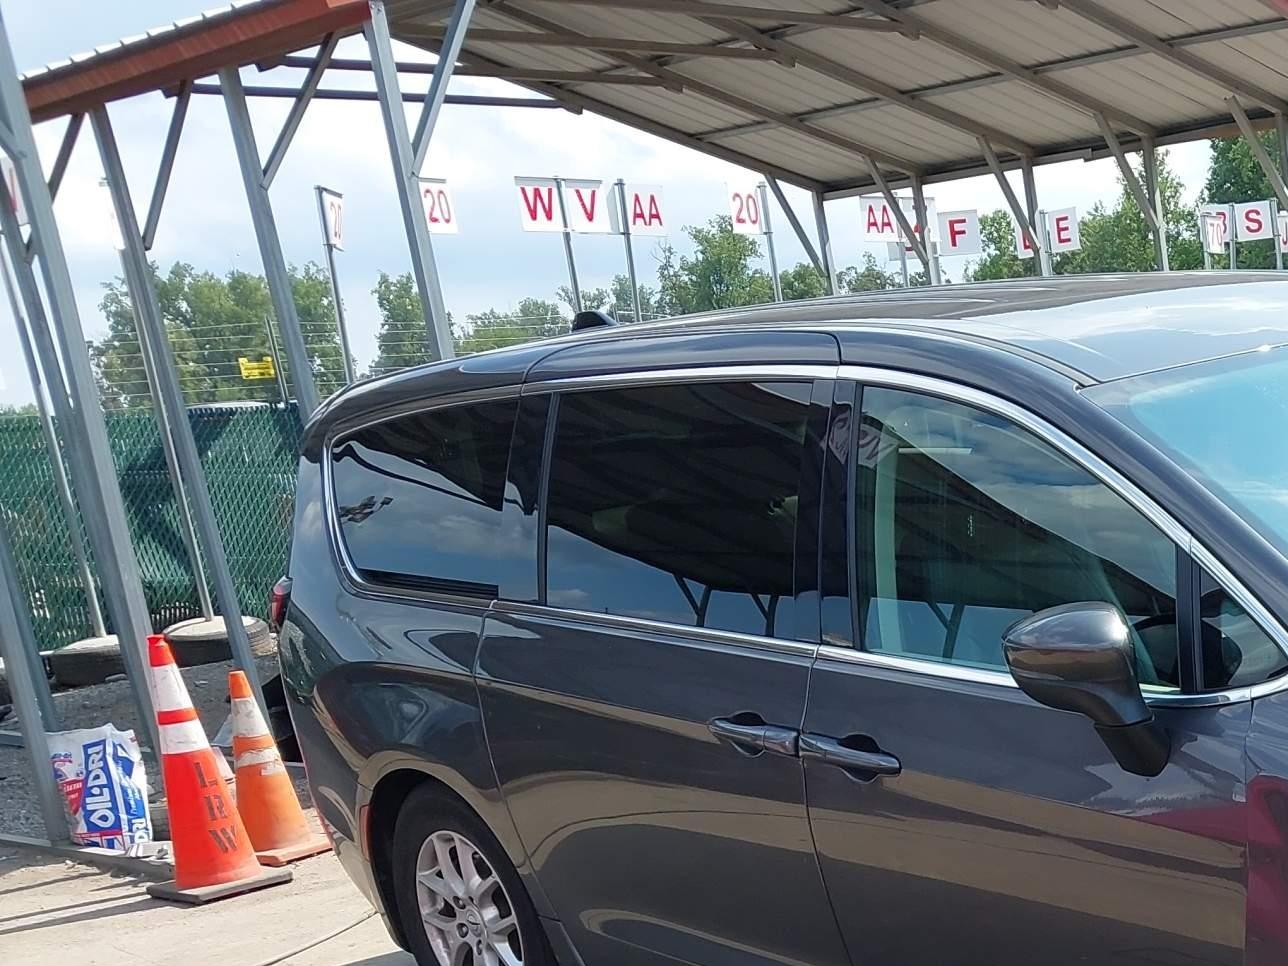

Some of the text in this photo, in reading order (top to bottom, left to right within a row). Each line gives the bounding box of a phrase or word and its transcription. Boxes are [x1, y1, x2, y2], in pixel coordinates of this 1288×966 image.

[423, 188, 452, 225] 20
[519, 186, 553, 222] W
[575, 189, 597, 223] V
[632, 193, 663, 227] AA
[732, 192, 759, 224] 20
[866, 204, 895, 234] AA
[947, 217, 967, 248] F
[1055, 215, 1072, 244] E
[1244, 208, 1263, 234] S
